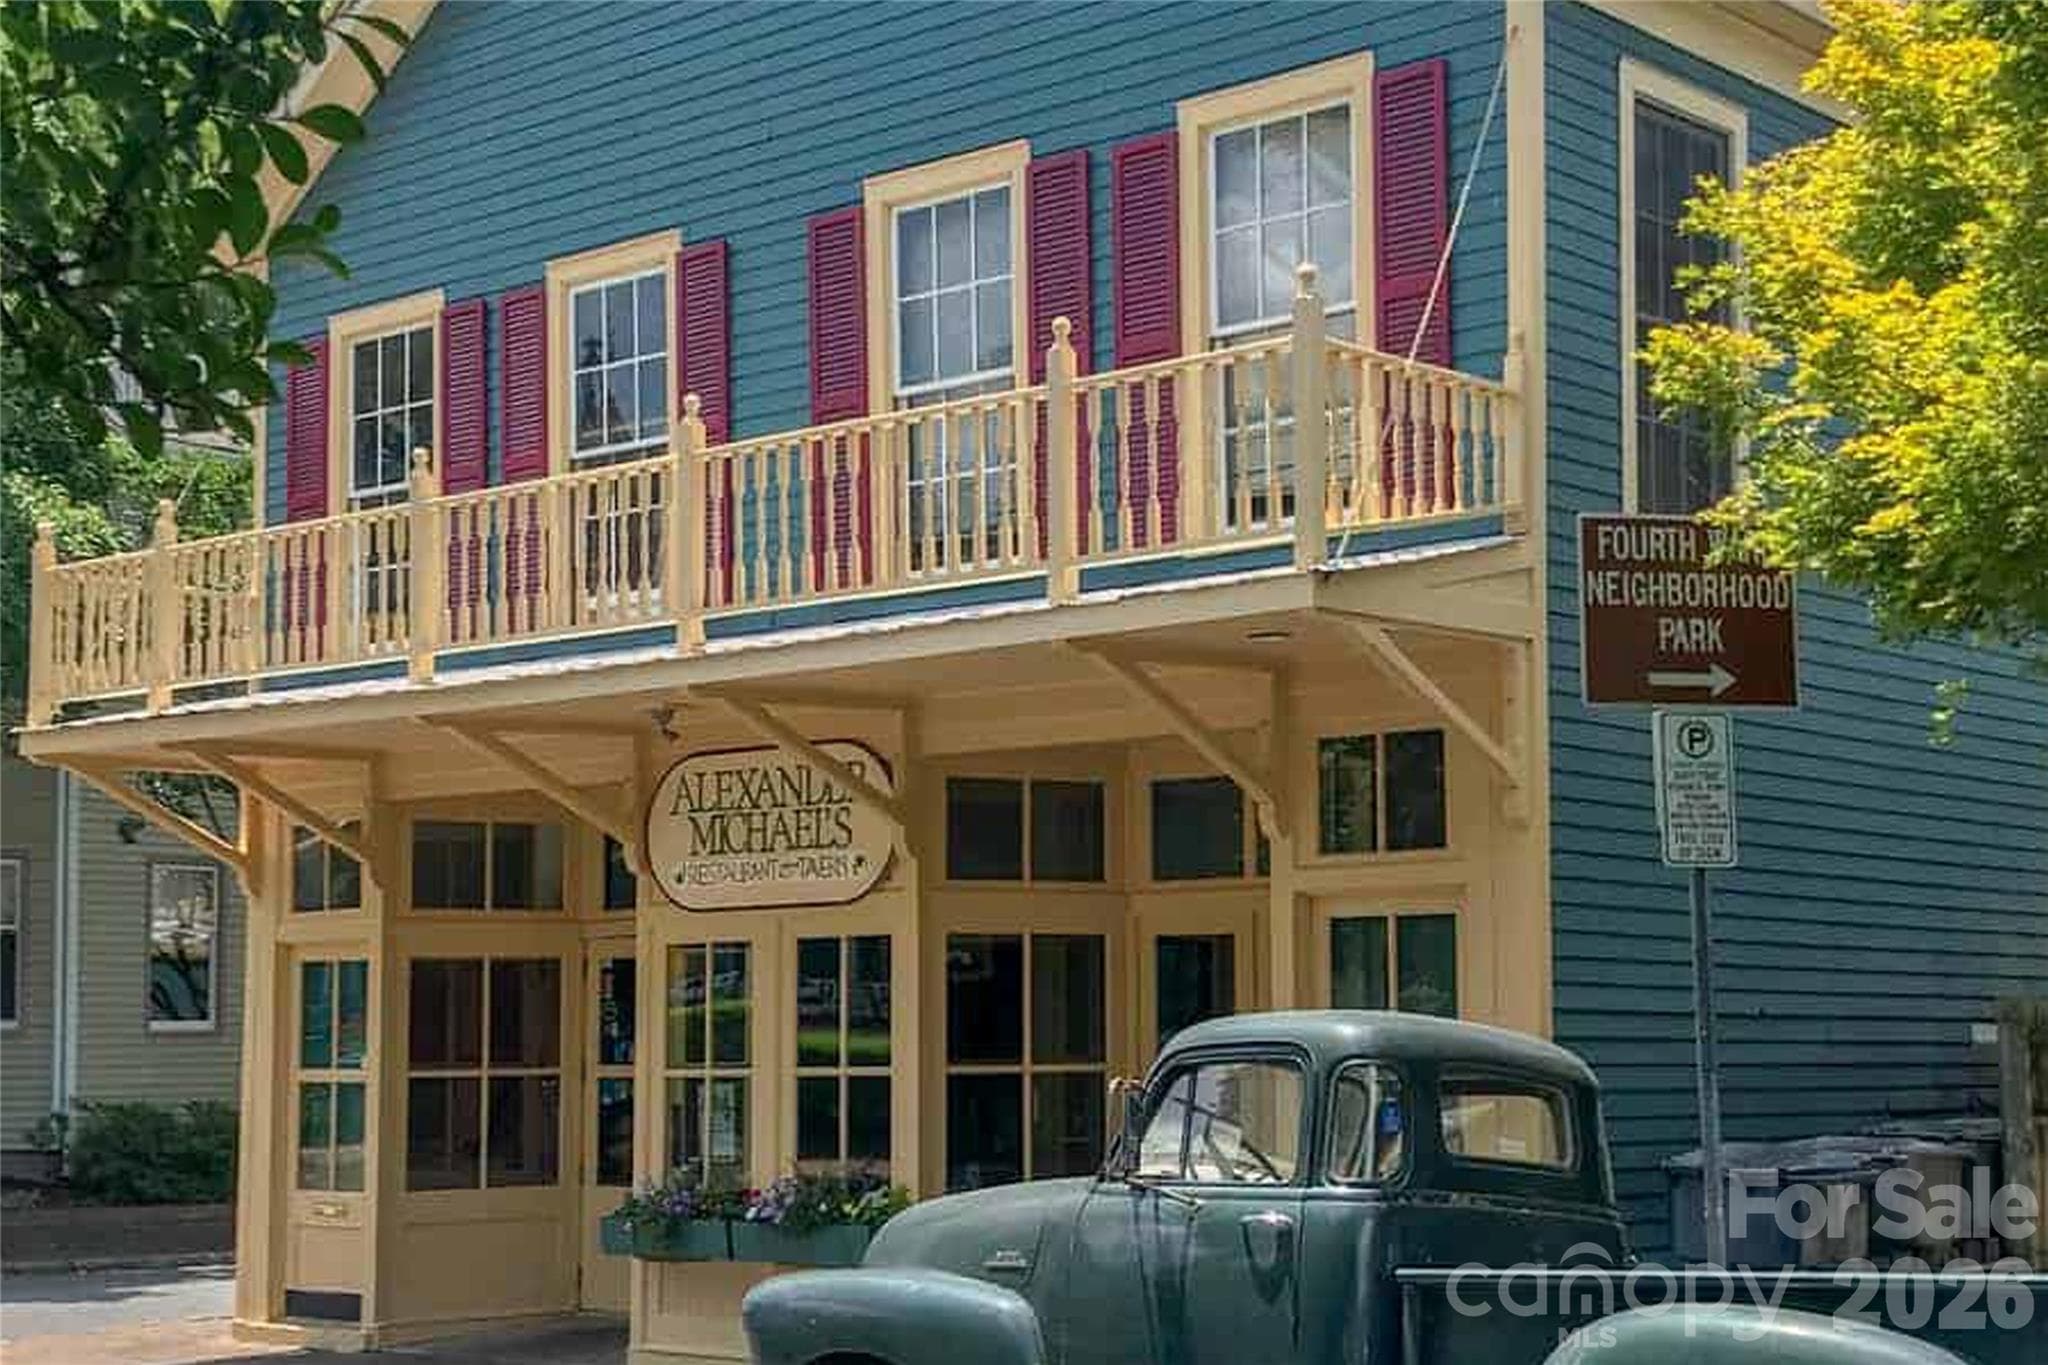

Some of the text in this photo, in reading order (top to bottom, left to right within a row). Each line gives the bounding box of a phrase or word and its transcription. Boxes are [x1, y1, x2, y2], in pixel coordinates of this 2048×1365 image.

[1597, 525, 1697, 562] FOURTH
[1585, 569, 1789, 609] NEIGHBORHOOD
[1658, 616, 1724, 653] PARK
[1688, 727, 1707, 750] P
[687, 807, 853, 857] MICHAEL'S
